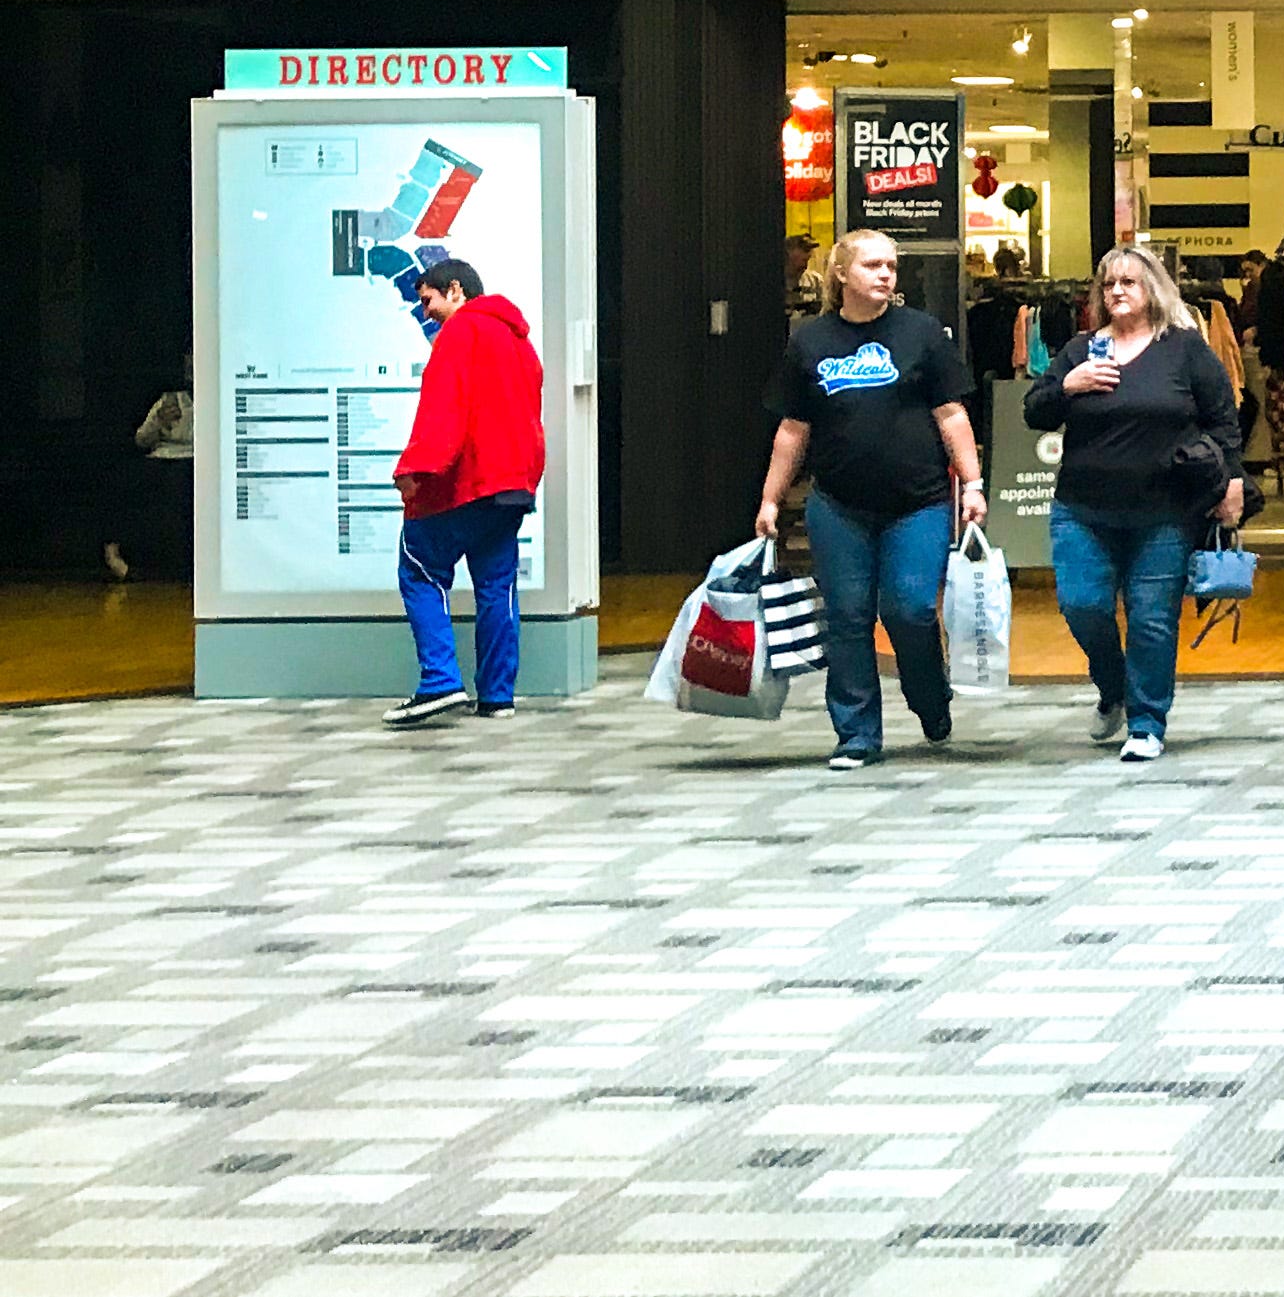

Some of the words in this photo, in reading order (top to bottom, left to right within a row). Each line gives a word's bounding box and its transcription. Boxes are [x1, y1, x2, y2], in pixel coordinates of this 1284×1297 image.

[279, 54, 513, 85] DIRECTORY
[853, 120, 950, 145] BLACK
[853, 145, 950, 168] FRIDAY
[869, 166, 933, 192] DEALS!
[1016, 471, 1056, 483] same
[999, 485, 1056, 502] appoint
[1016, 501, 1052, 516] avail
